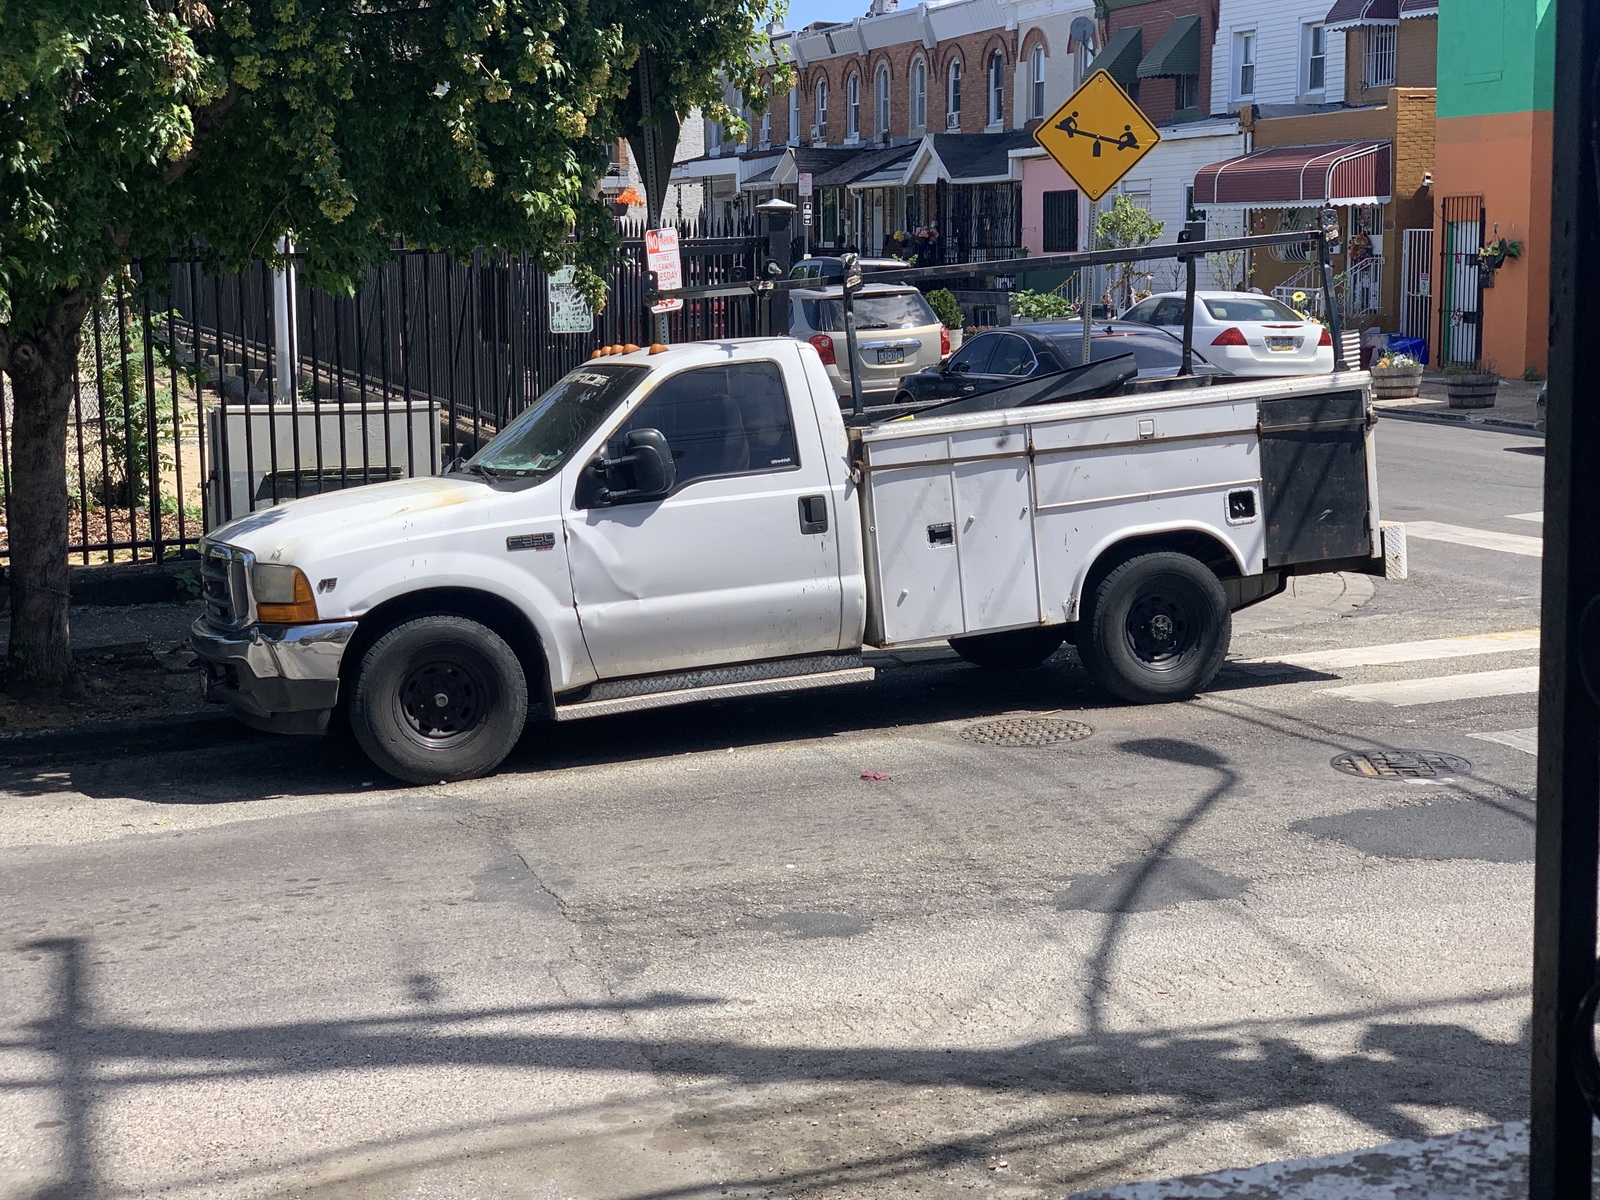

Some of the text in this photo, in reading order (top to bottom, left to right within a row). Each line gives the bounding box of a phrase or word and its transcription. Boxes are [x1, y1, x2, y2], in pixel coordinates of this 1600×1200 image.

[648, 234, 675, 250] NO PARKING
[655, 253, 672, 262] STREET
[653, 262, 677, 271] CLEANING
